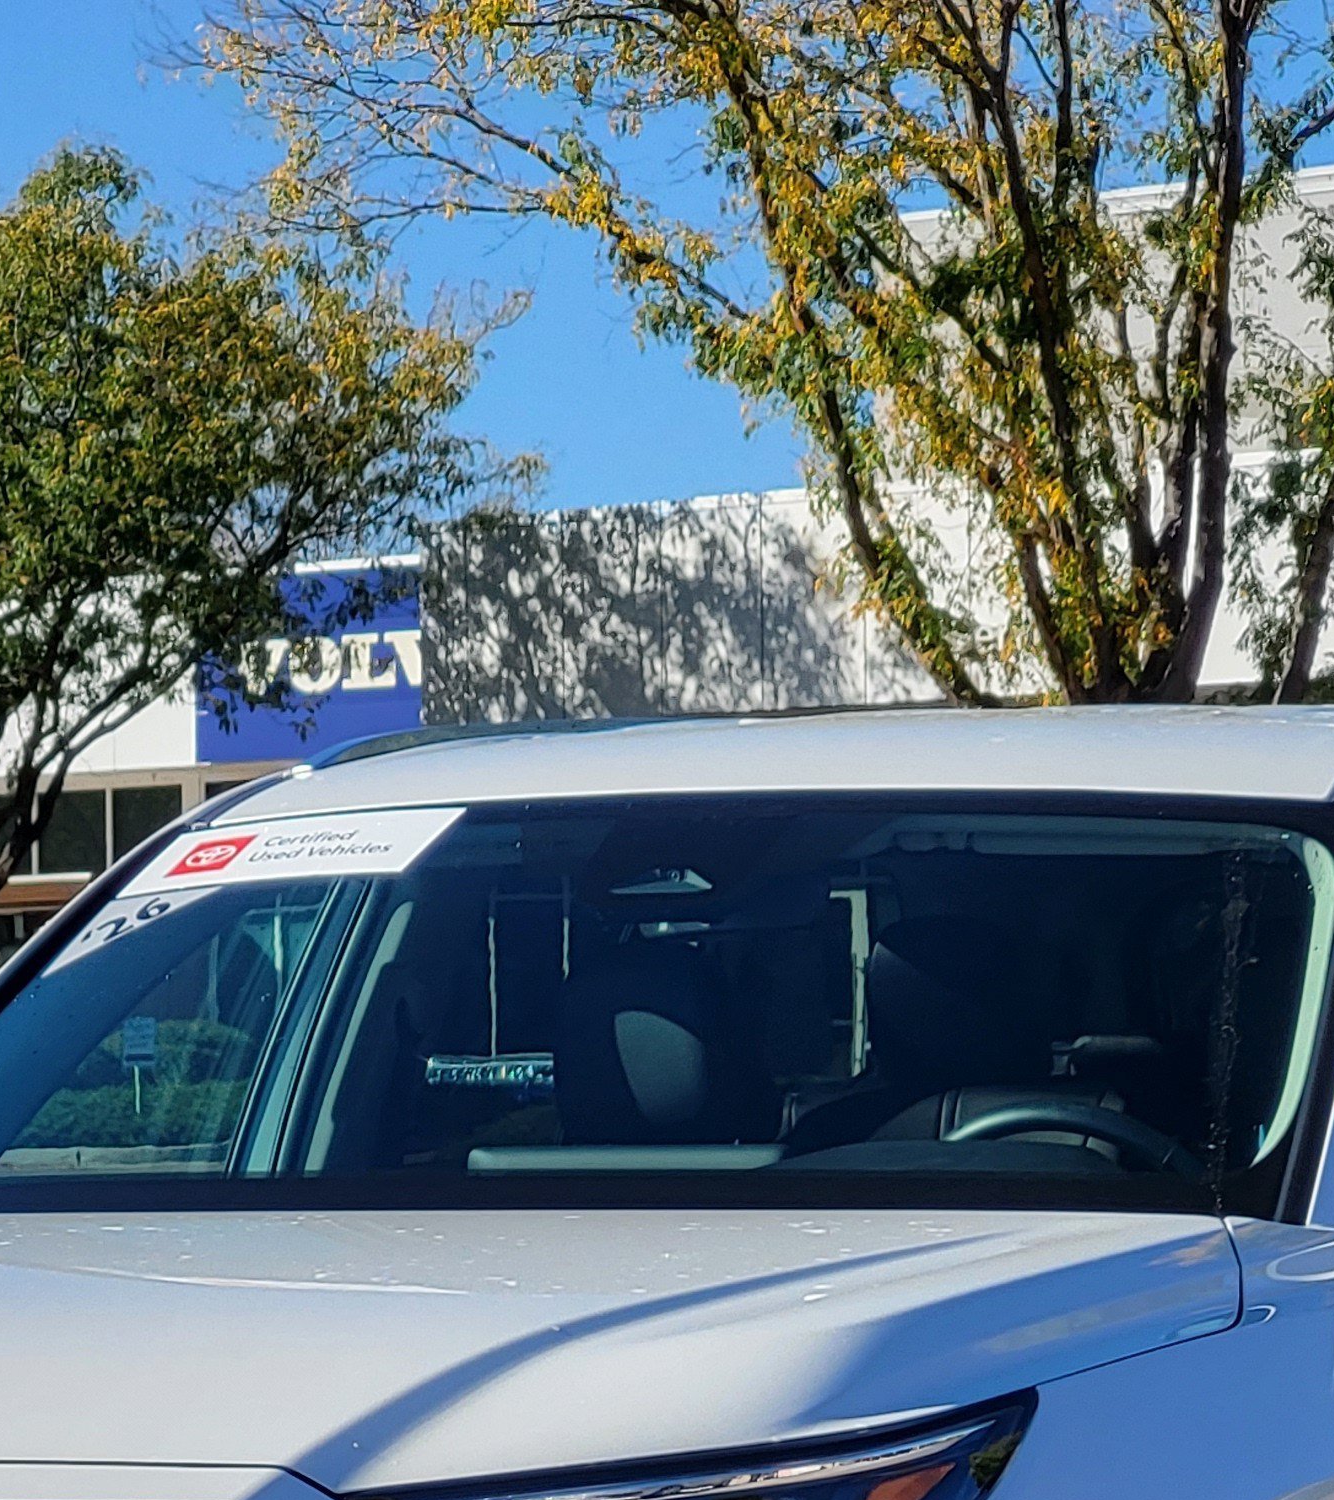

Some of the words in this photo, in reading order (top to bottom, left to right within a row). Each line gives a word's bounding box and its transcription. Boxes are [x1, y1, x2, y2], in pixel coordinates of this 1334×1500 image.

[229, 629, 422, 694] VOLV
[264, 829, 359, 847] Certified
[247, 848, 302, 863] Used
[307, 841, 393, 858] Vehicles
